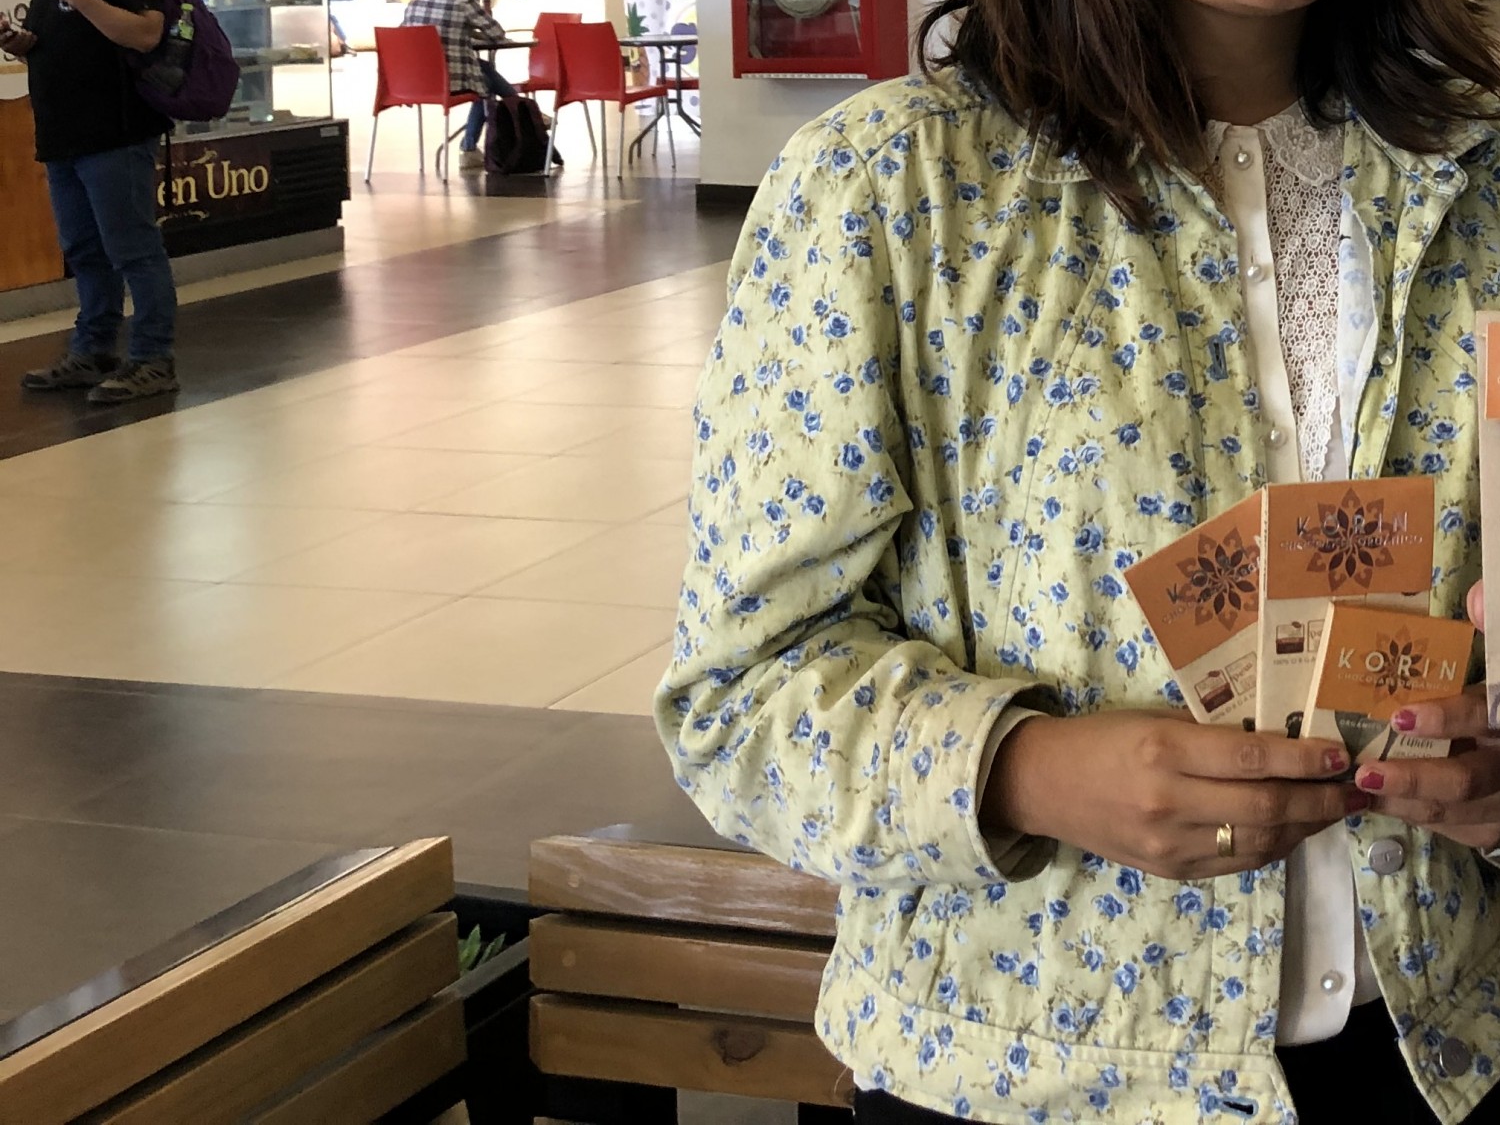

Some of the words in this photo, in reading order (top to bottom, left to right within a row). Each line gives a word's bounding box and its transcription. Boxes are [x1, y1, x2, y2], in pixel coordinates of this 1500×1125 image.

[205, 160, 268, 198] Uno
[1296, 511, 1408, 537] KORIN
[1338, 647, 1457, 681] KORIN
[1337, 673, 1394, 686] CHOCOLATE
